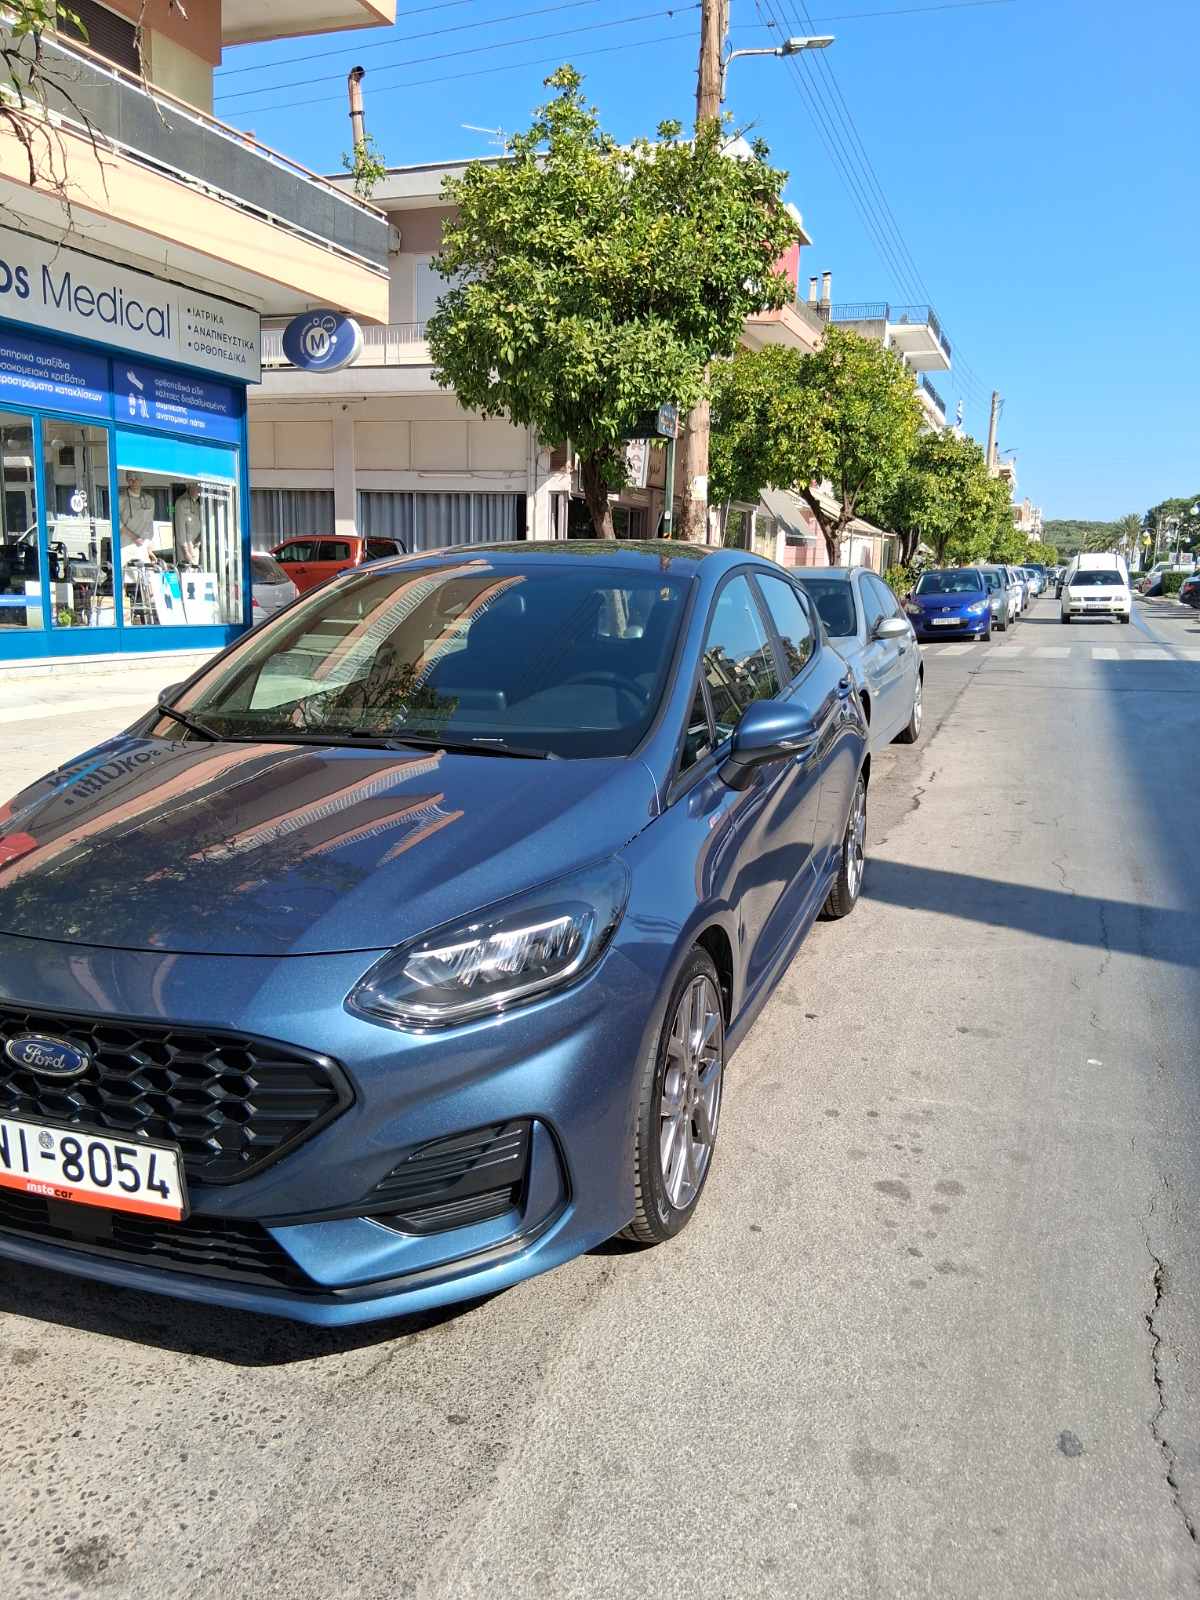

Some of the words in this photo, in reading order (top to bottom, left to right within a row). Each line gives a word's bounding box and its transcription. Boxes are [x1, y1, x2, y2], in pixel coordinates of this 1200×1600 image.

[42, 265, 171, 340] Medical
[192, 308, 225, 325] ΙΑΤΡΙΚΑ
[193, 325, 255, 351] ΑΝΑΠΝΕΥΣΤΙΚΑ
[311, 333, 325, 351] M
[36, 356, 71, 370] αμαξίδια
[193, 341, 247, 364] ΟΡΘΟΠΕΔΙΚΑ
[0, 362, 49, 378] σοκομειακά
[51, 372, 86, 386] κρεβάτια
[22, 1043, 65, 1070] Ford
